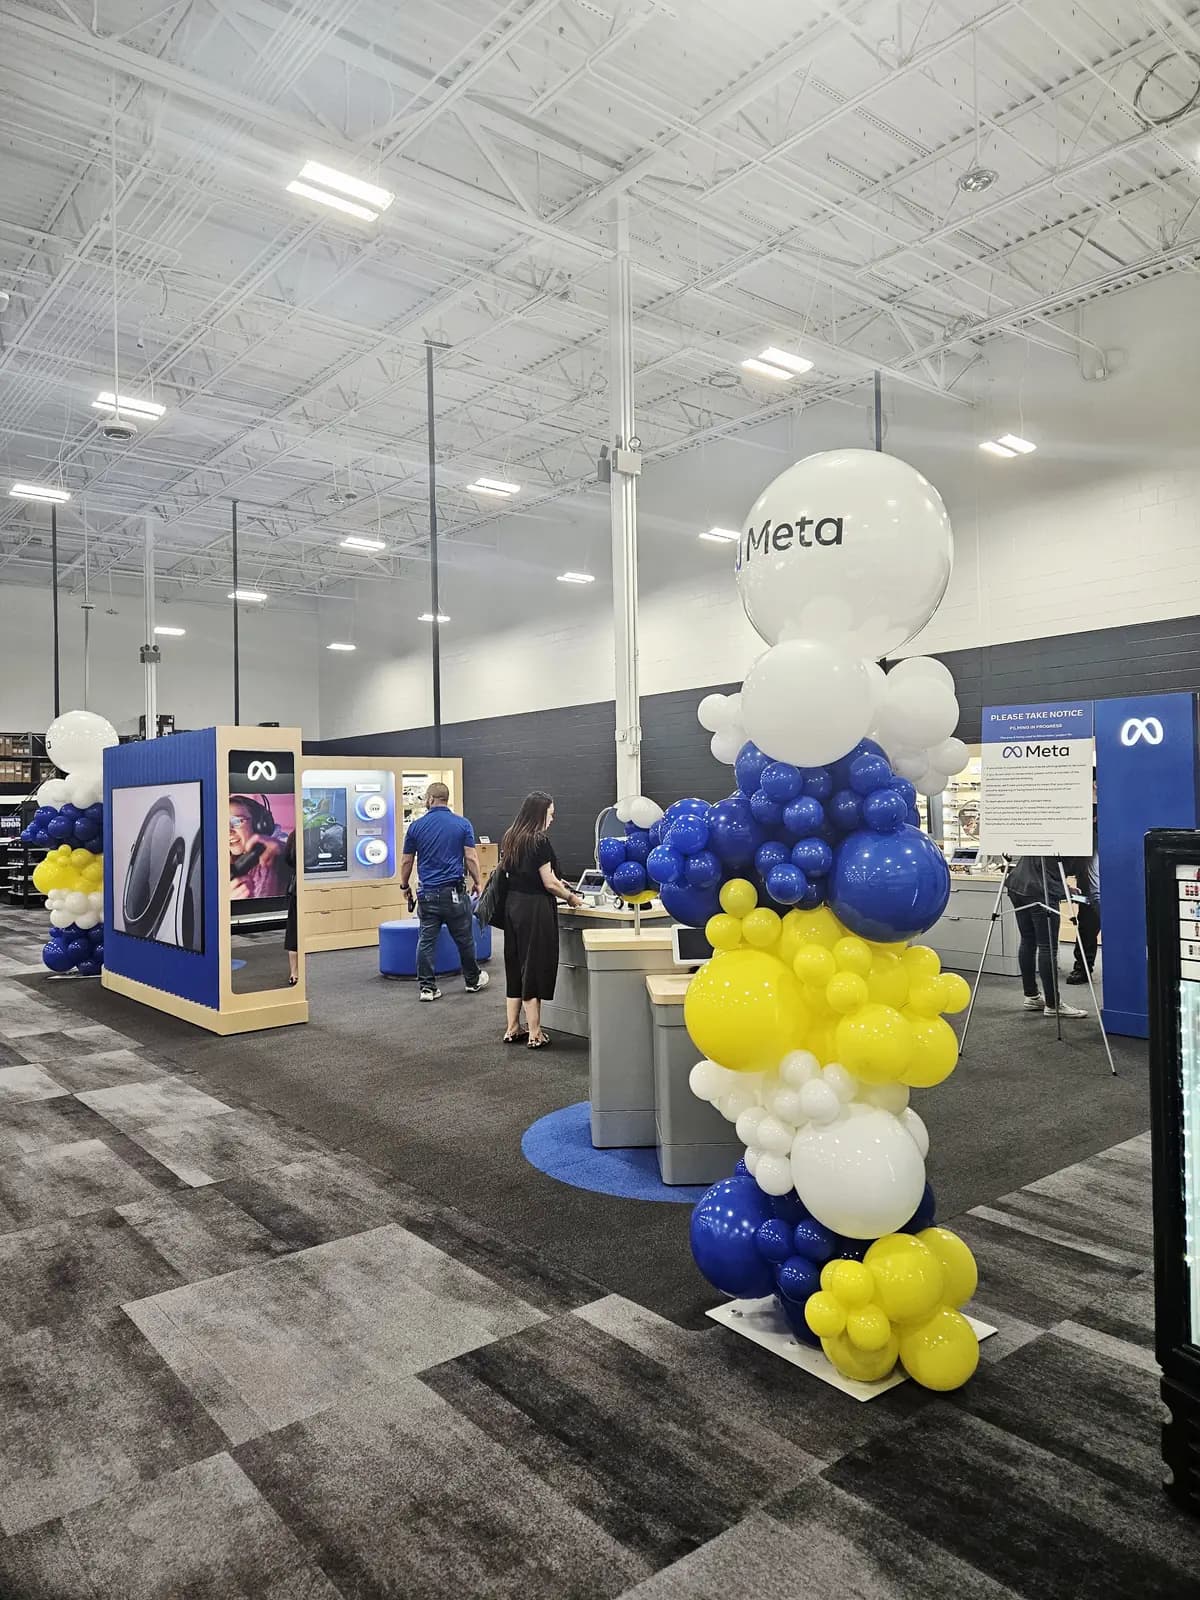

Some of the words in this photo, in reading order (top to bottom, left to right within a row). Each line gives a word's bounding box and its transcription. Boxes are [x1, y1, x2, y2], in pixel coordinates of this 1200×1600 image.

[747, 516, 843, 561] Meta
[990, 713, 1024, 721] PLEASE
[1025, 711, 1048, 719] TAKE
[1049, 709, 1084, 718] NOTICE
[1026, 745, 1069, 758] Meta
